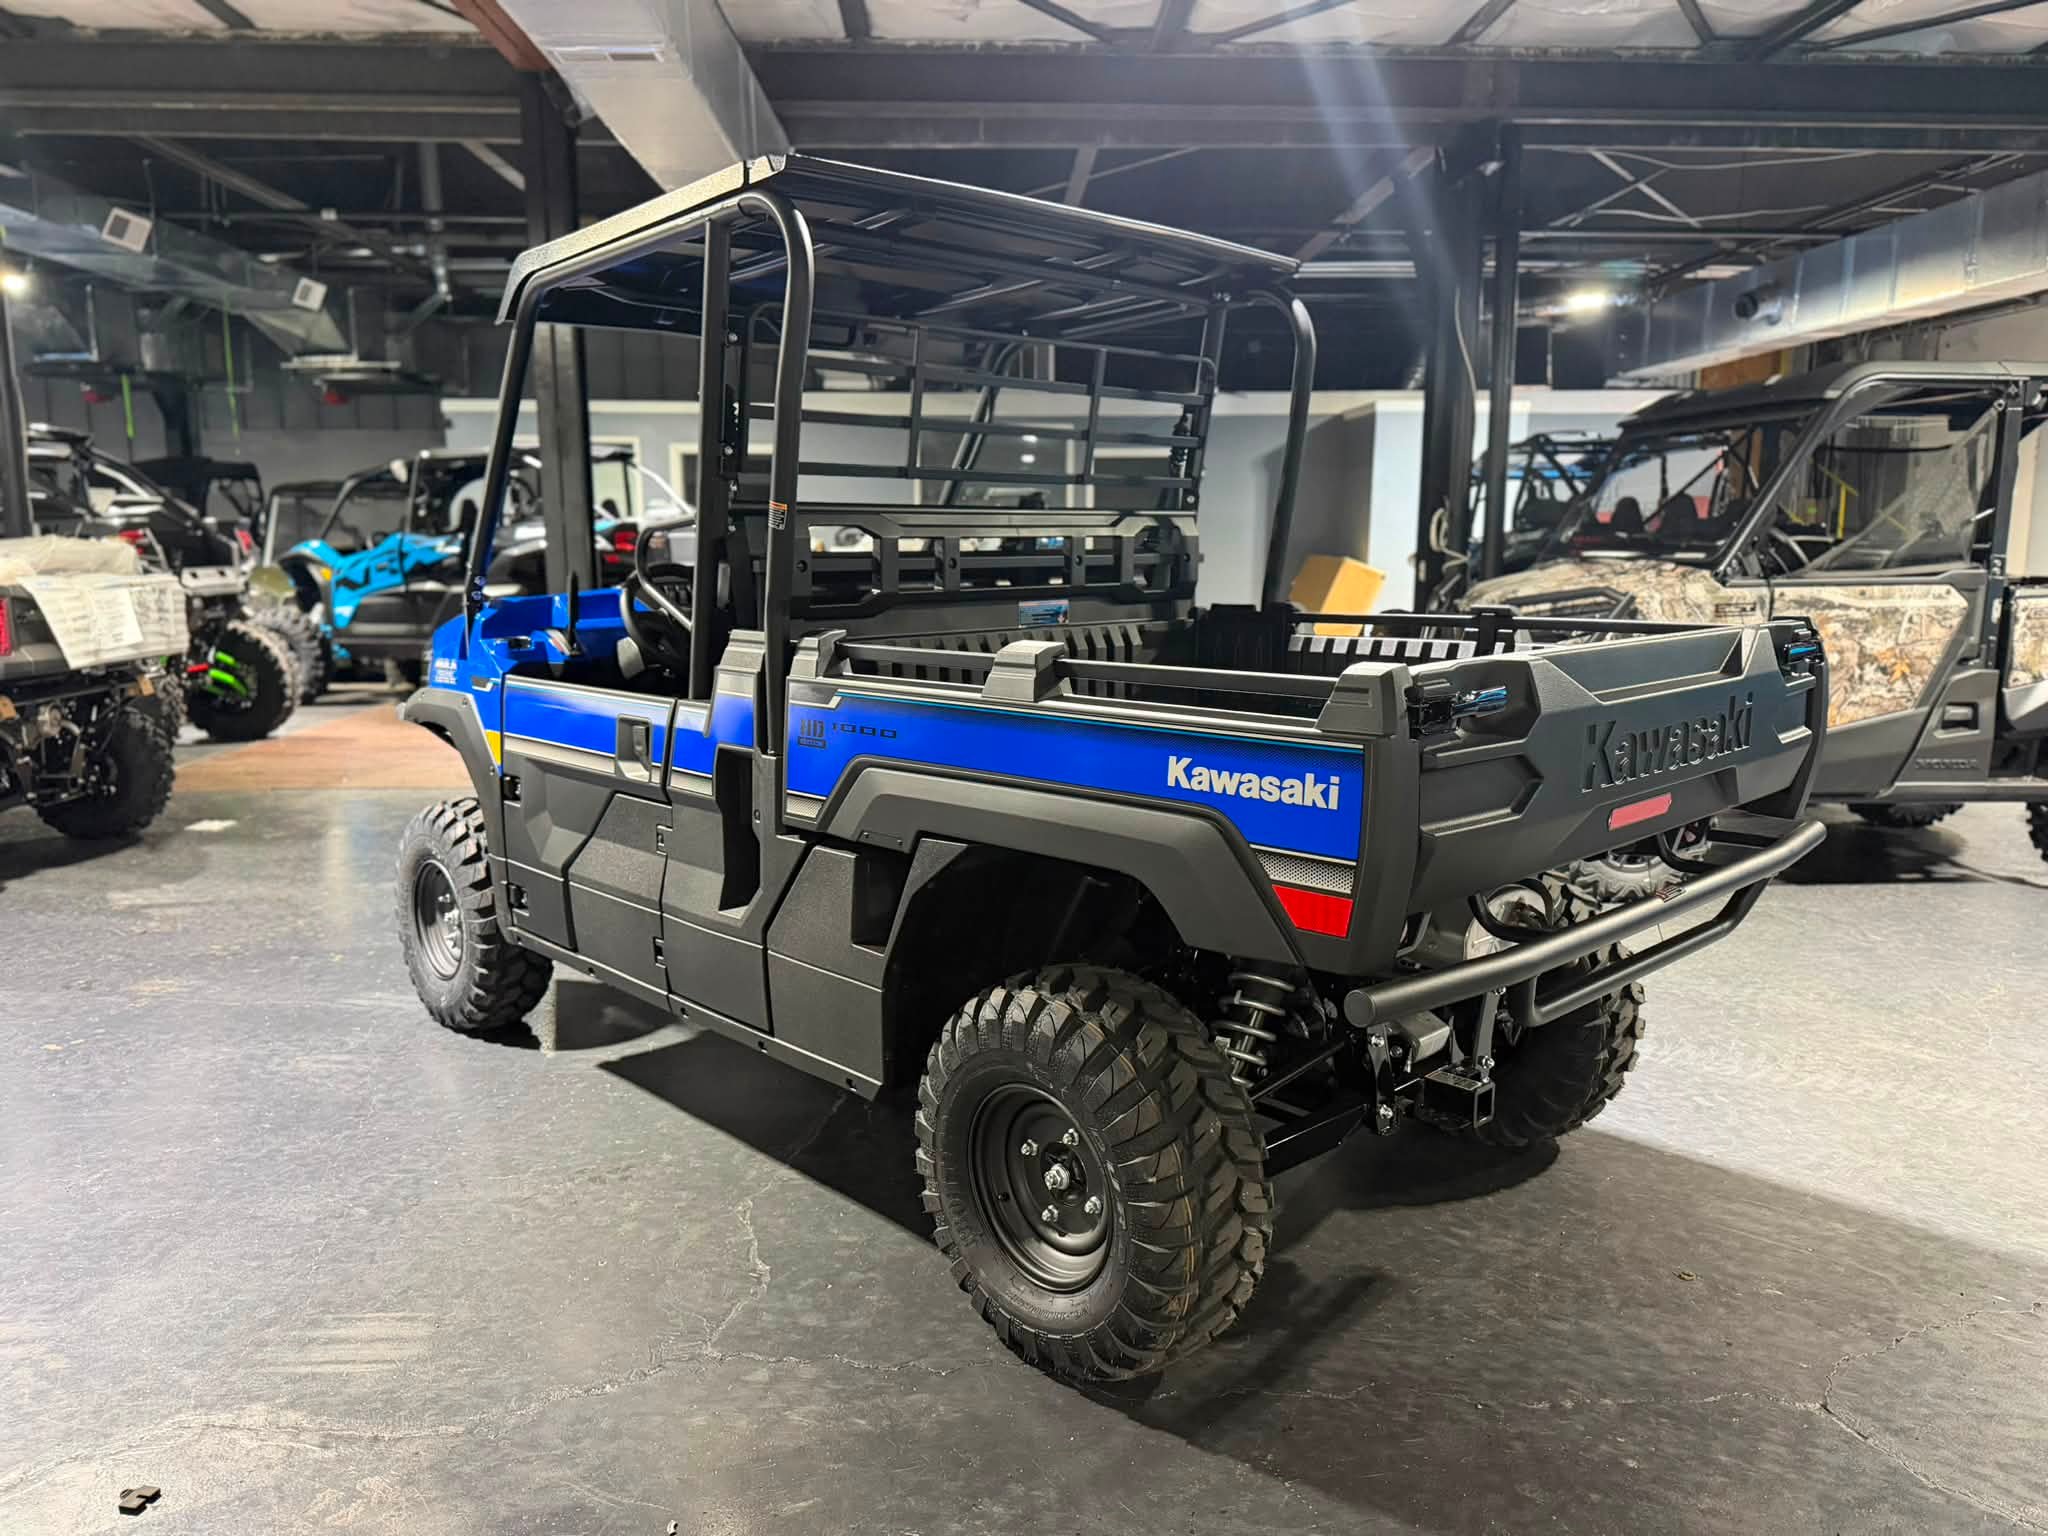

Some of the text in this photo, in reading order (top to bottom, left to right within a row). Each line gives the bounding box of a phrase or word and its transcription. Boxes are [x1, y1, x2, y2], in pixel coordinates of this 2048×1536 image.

[831, 721, 897, 739] 1000
[1582, 691, 1753, 793] Kawasaki
[1167, 755, 1340, 810] Kawasaki
